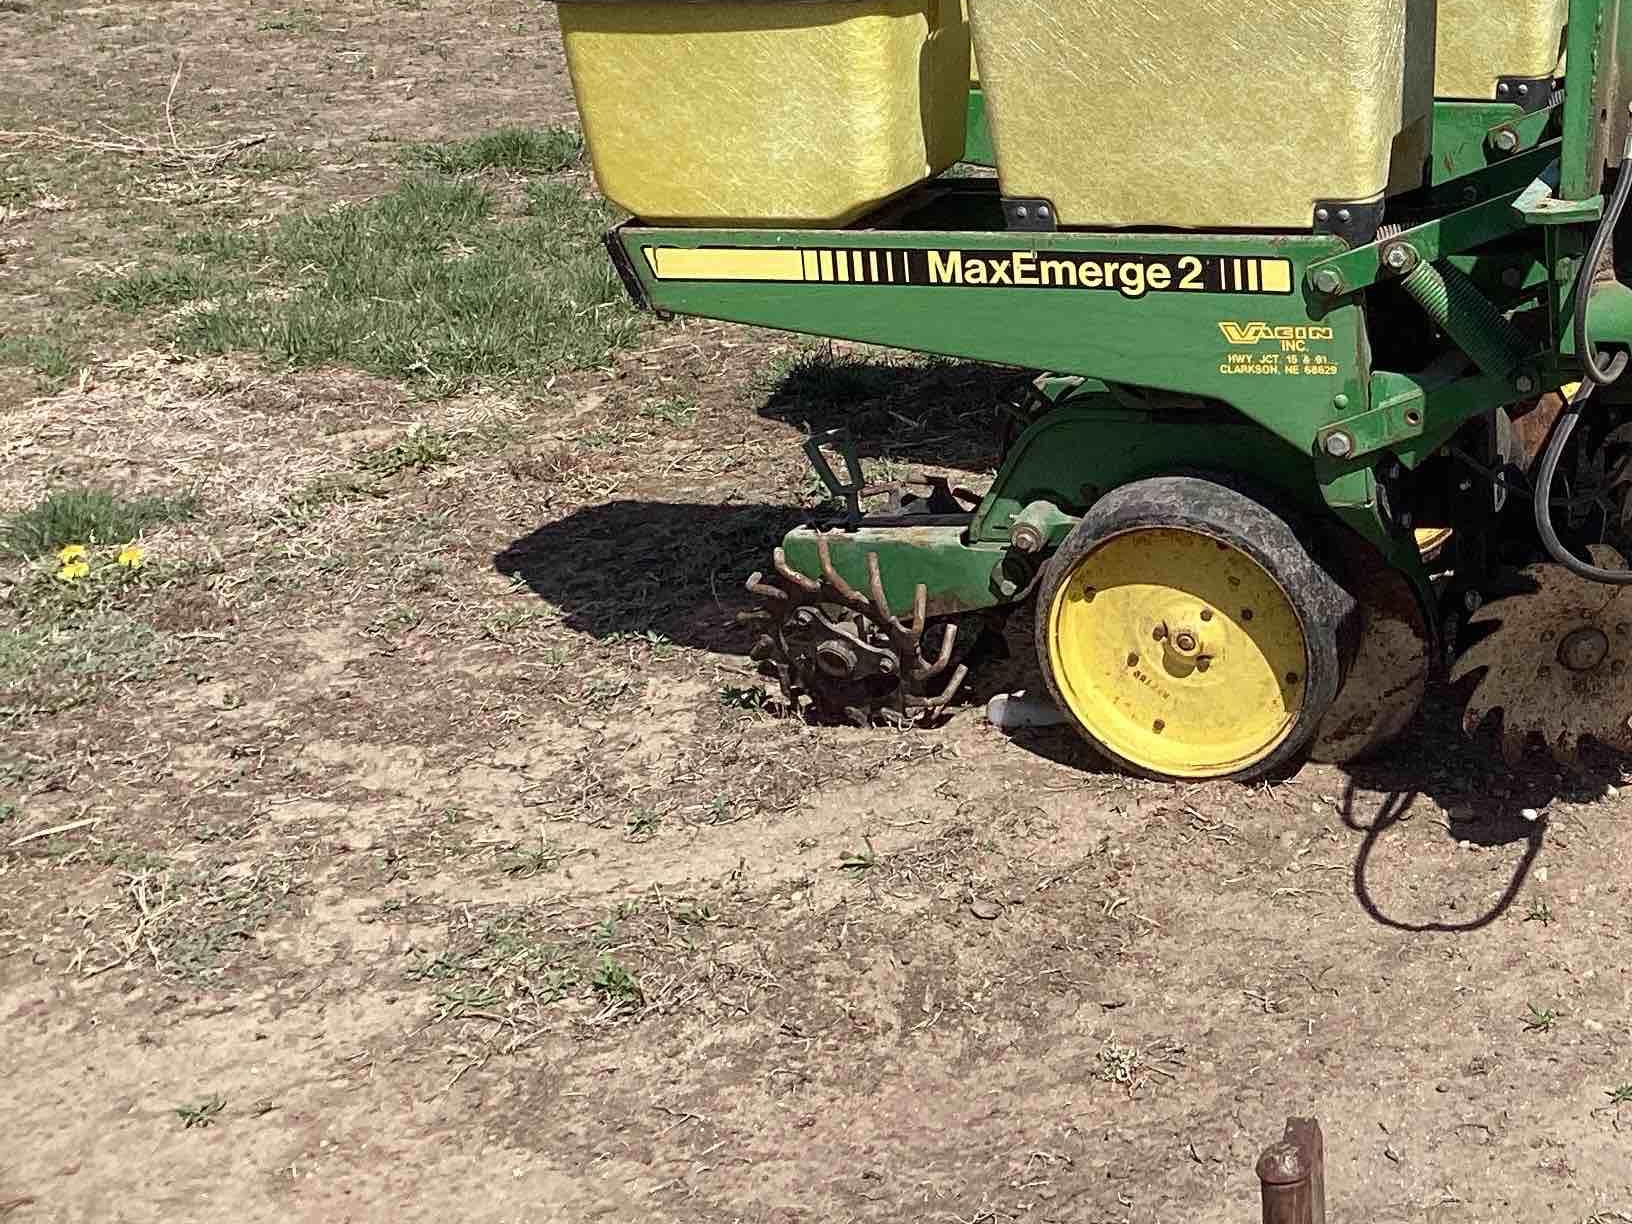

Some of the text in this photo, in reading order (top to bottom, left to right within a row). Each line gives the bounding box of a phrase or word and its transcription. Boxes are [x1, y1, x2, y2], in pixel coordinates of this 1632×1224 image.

[927, 250, 1204, 296] MaxEmerge 2
[1280, 339, 1309, 352] INC.
